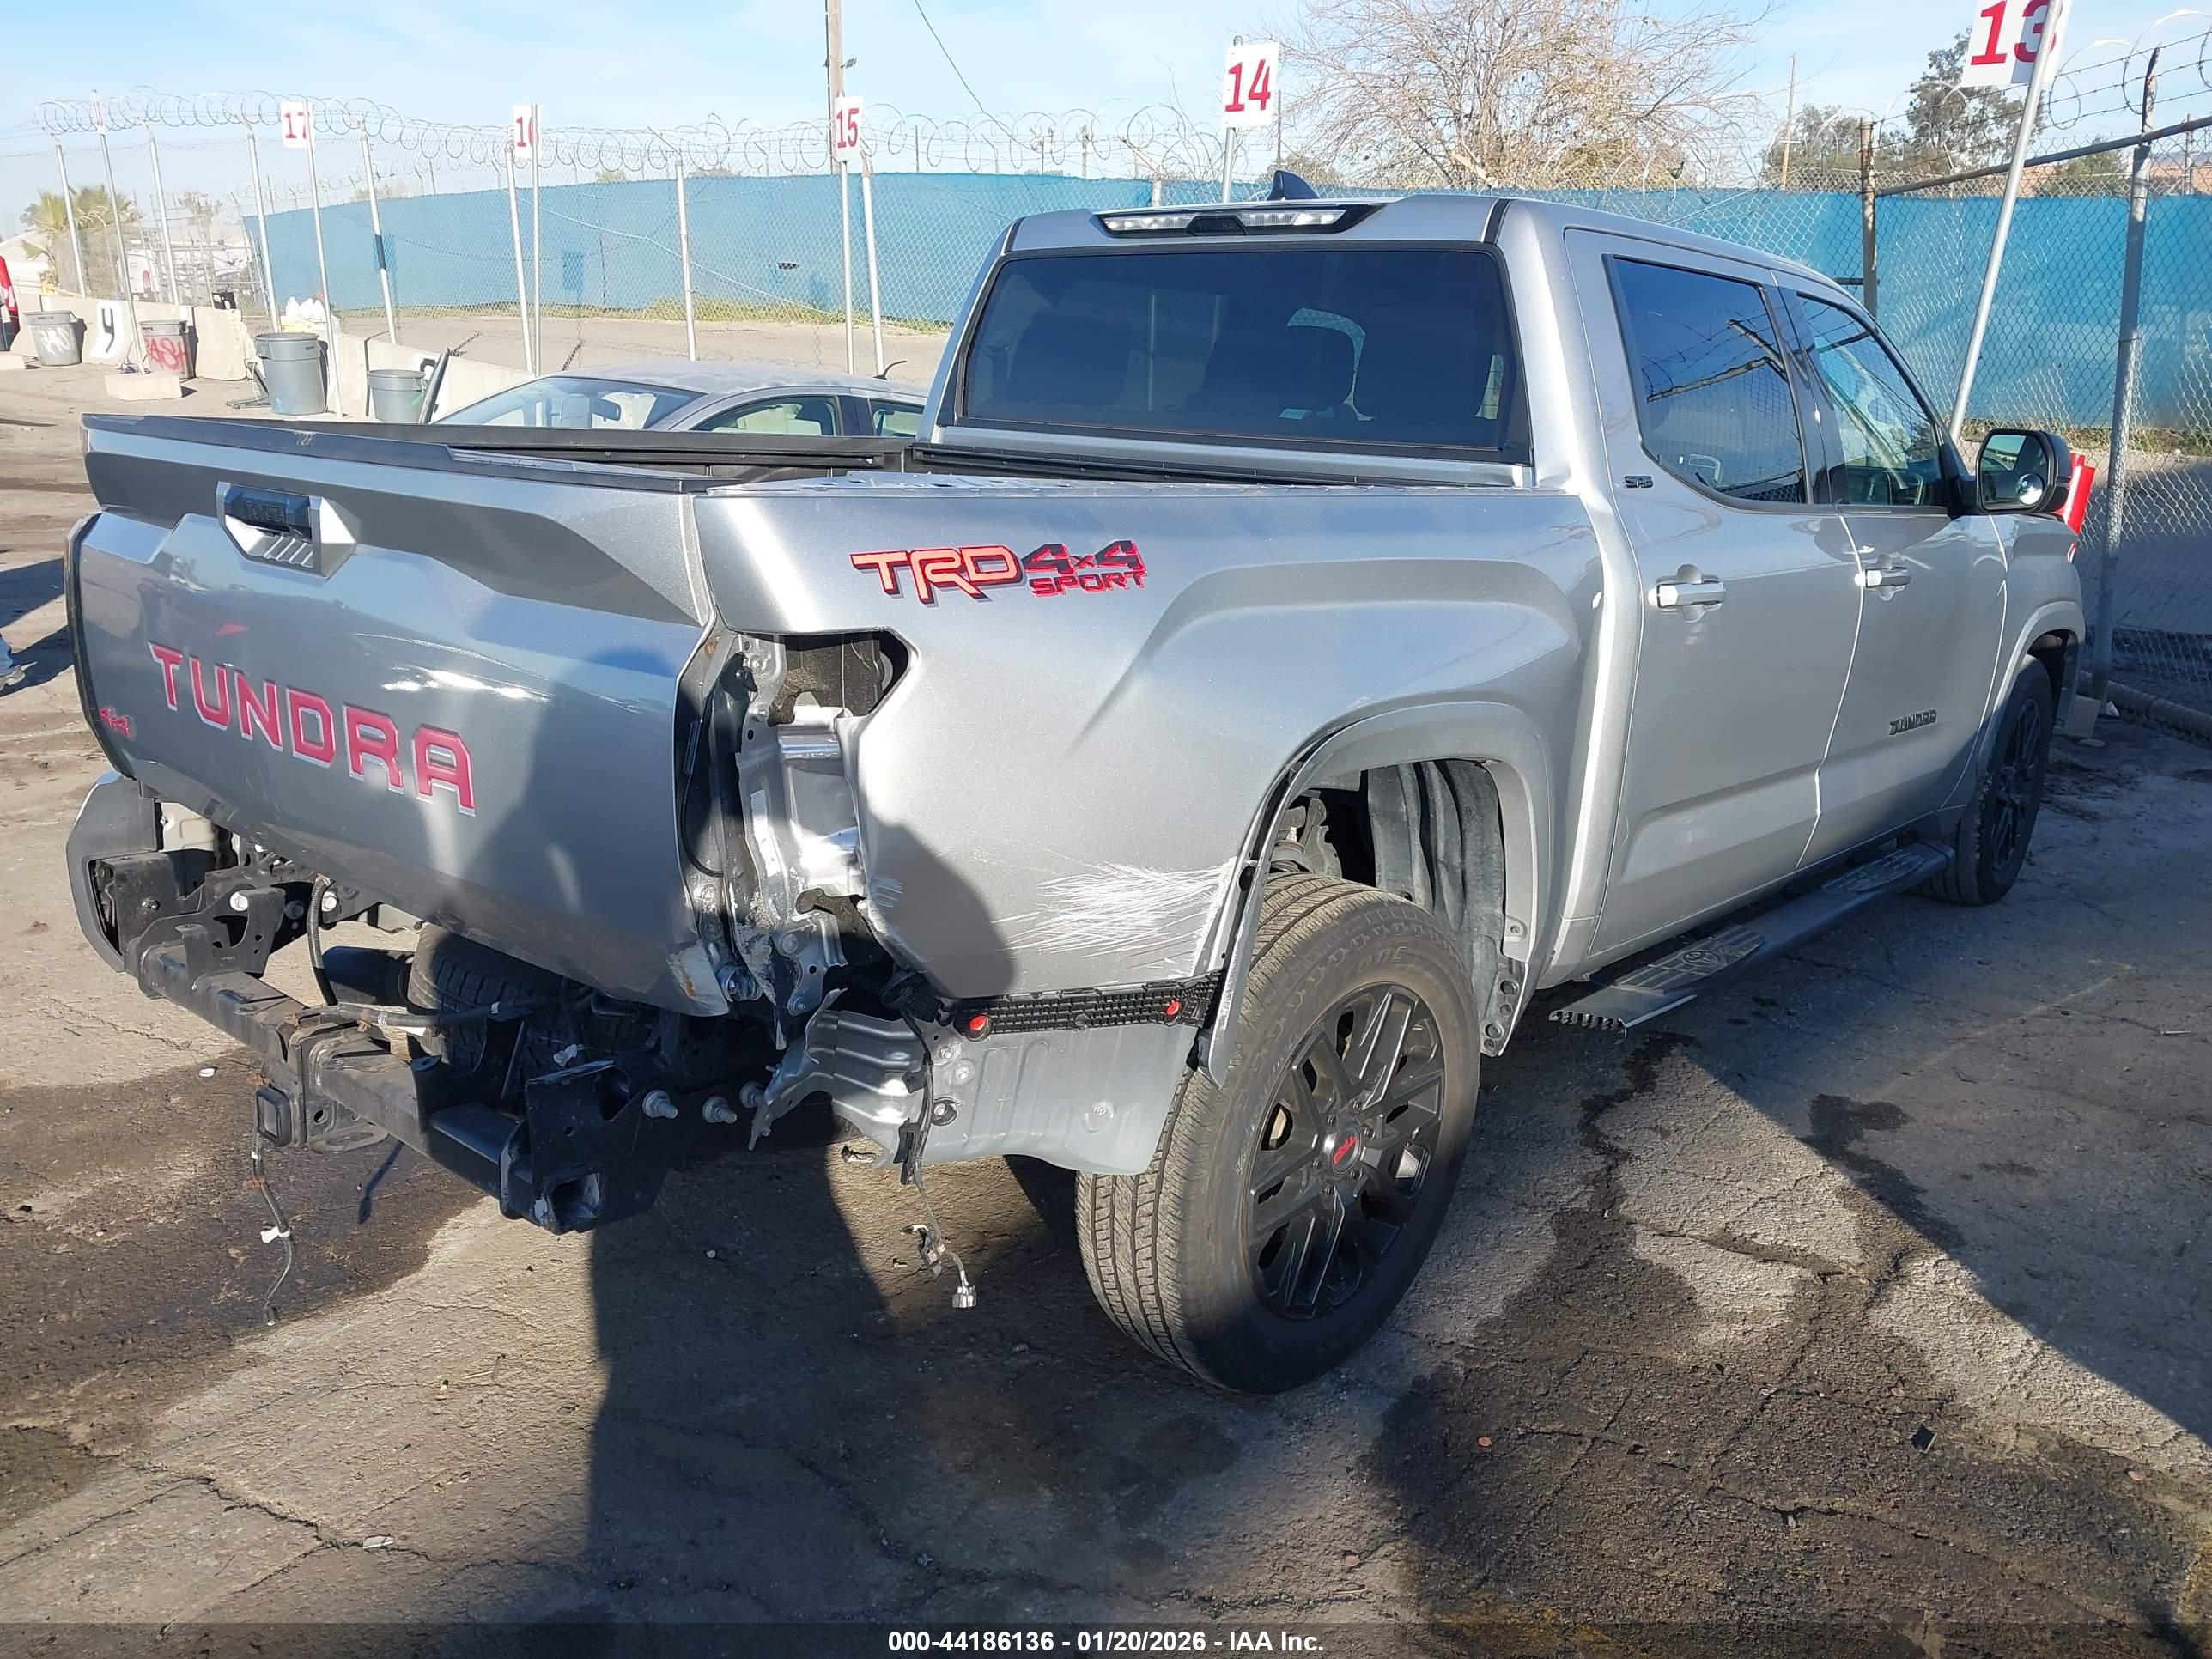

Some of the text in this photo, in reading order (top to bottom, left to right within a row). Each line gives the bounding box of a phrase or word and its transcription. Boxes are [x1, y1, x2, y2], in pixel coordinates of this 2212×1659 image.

[1971, 0, 2063, 65] 13
[1225, 59, 1271, 112] 14
[836, 108, 860, 148] 15
[850, 540, 1146, 604] TRD 4x4
[1029, 571, 1147, 597] SPORT
[147, 641, 476, 817] TUNDRA
